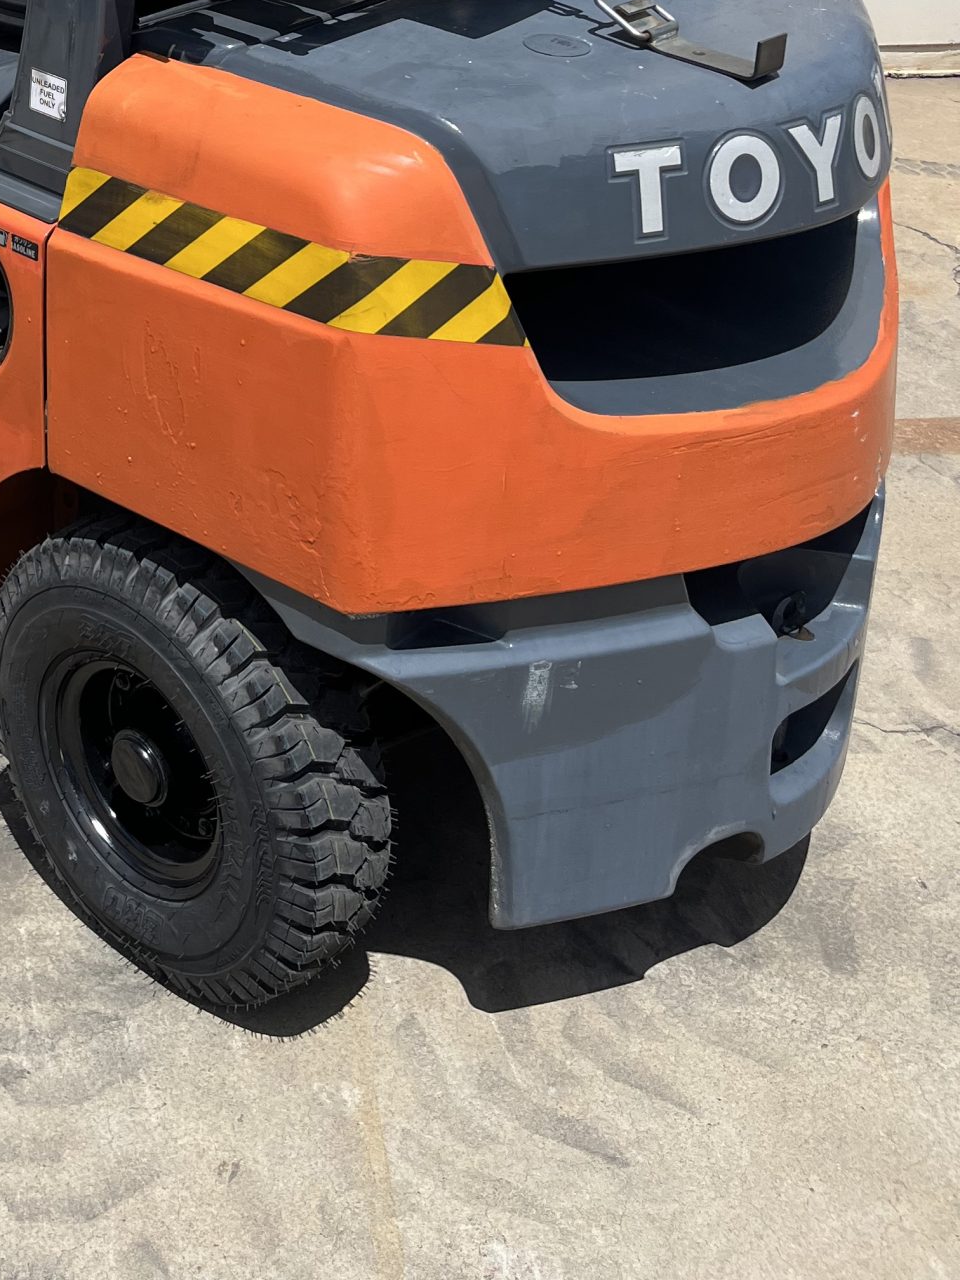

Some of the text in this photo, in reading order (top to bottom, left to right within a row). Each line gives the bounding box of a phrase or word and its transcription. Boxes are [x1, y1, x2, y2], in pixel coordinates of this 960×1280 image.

[32, 76, 65, 95] UNLEADED
[39, 88, 56, 101] FUEL
[39, 97, 56, 110] ONLY
[614, 70, 887, 233] TOYO
[12, 242, 37, 259] ASOLINE
